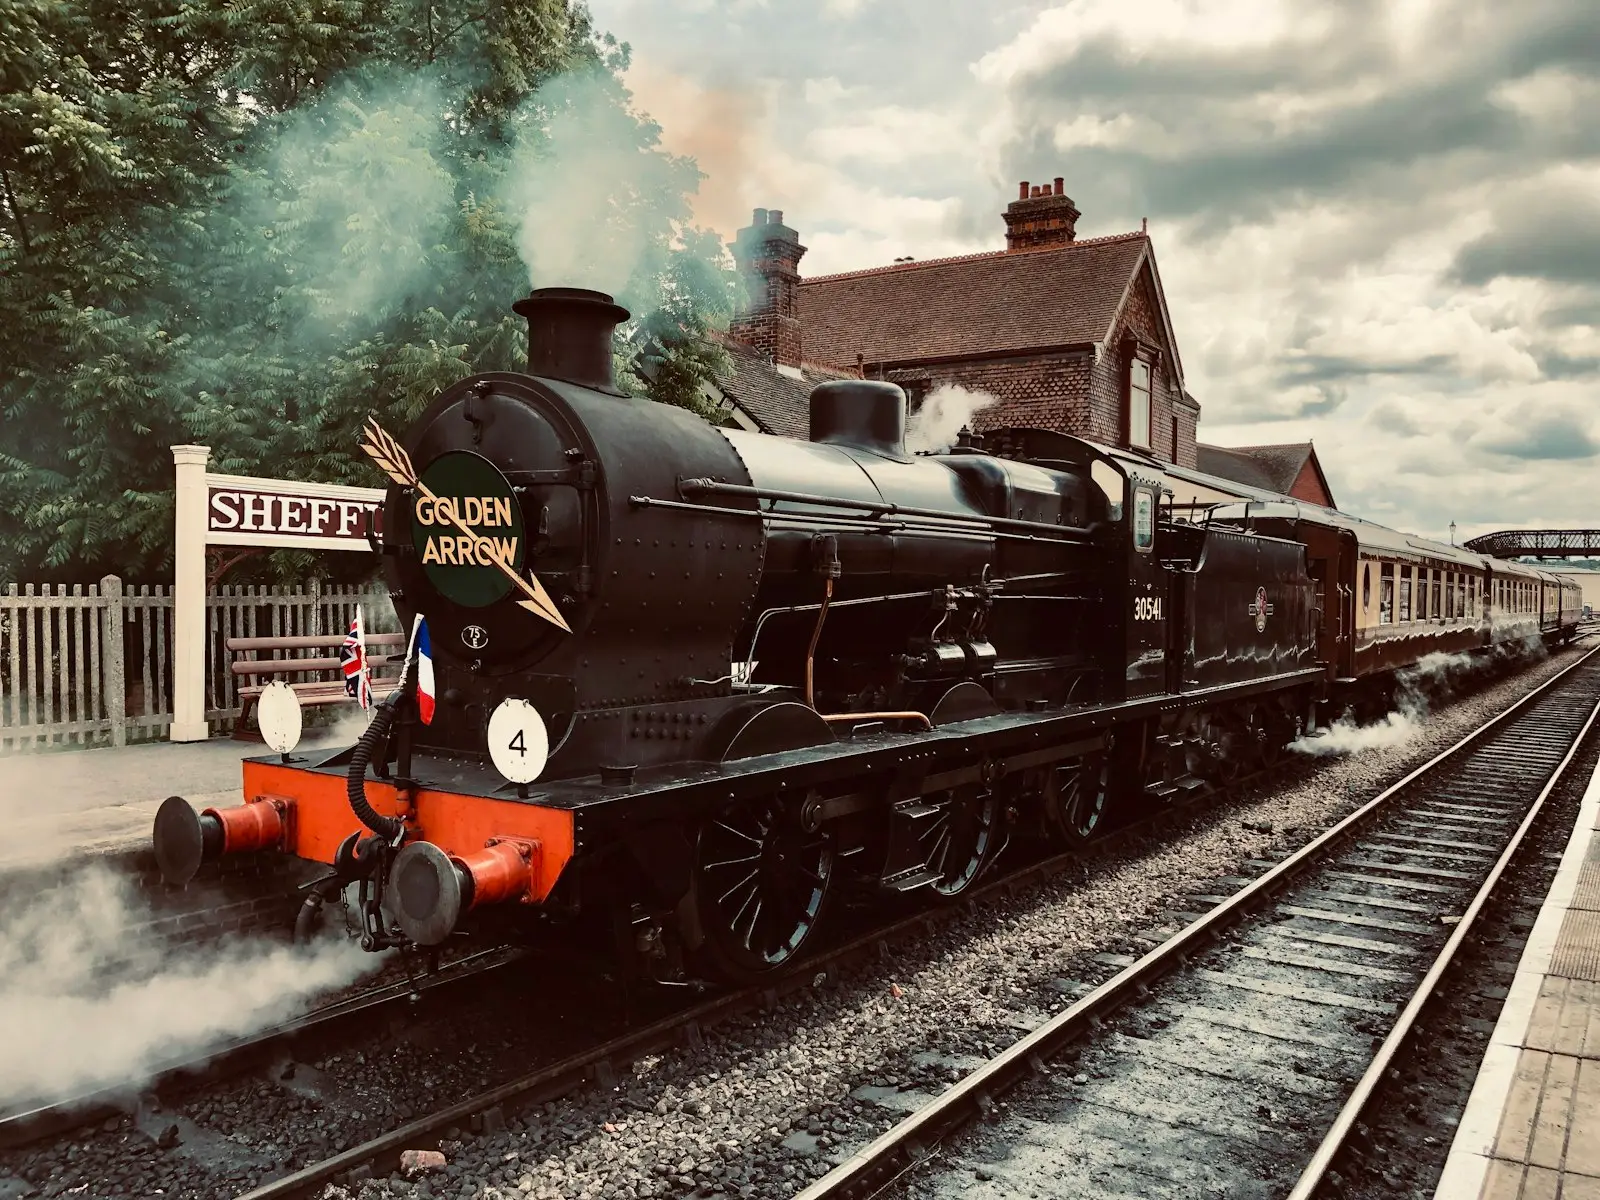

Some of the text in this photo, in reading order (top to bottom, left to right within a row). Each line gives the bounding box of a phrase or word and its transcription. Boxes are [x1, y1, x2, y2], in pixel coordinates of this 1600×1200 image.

[210, 491, 384, 537] SHEFF
[416, 496, 512, 527] GOLDEN
[422, 535, 518, 566] ARROW
[1134, 596, 1162, 621] 30541
[468, 627, 481, 639] 75
[472, 637, 478, 647] E
[508, 729, 528, 757] 4
